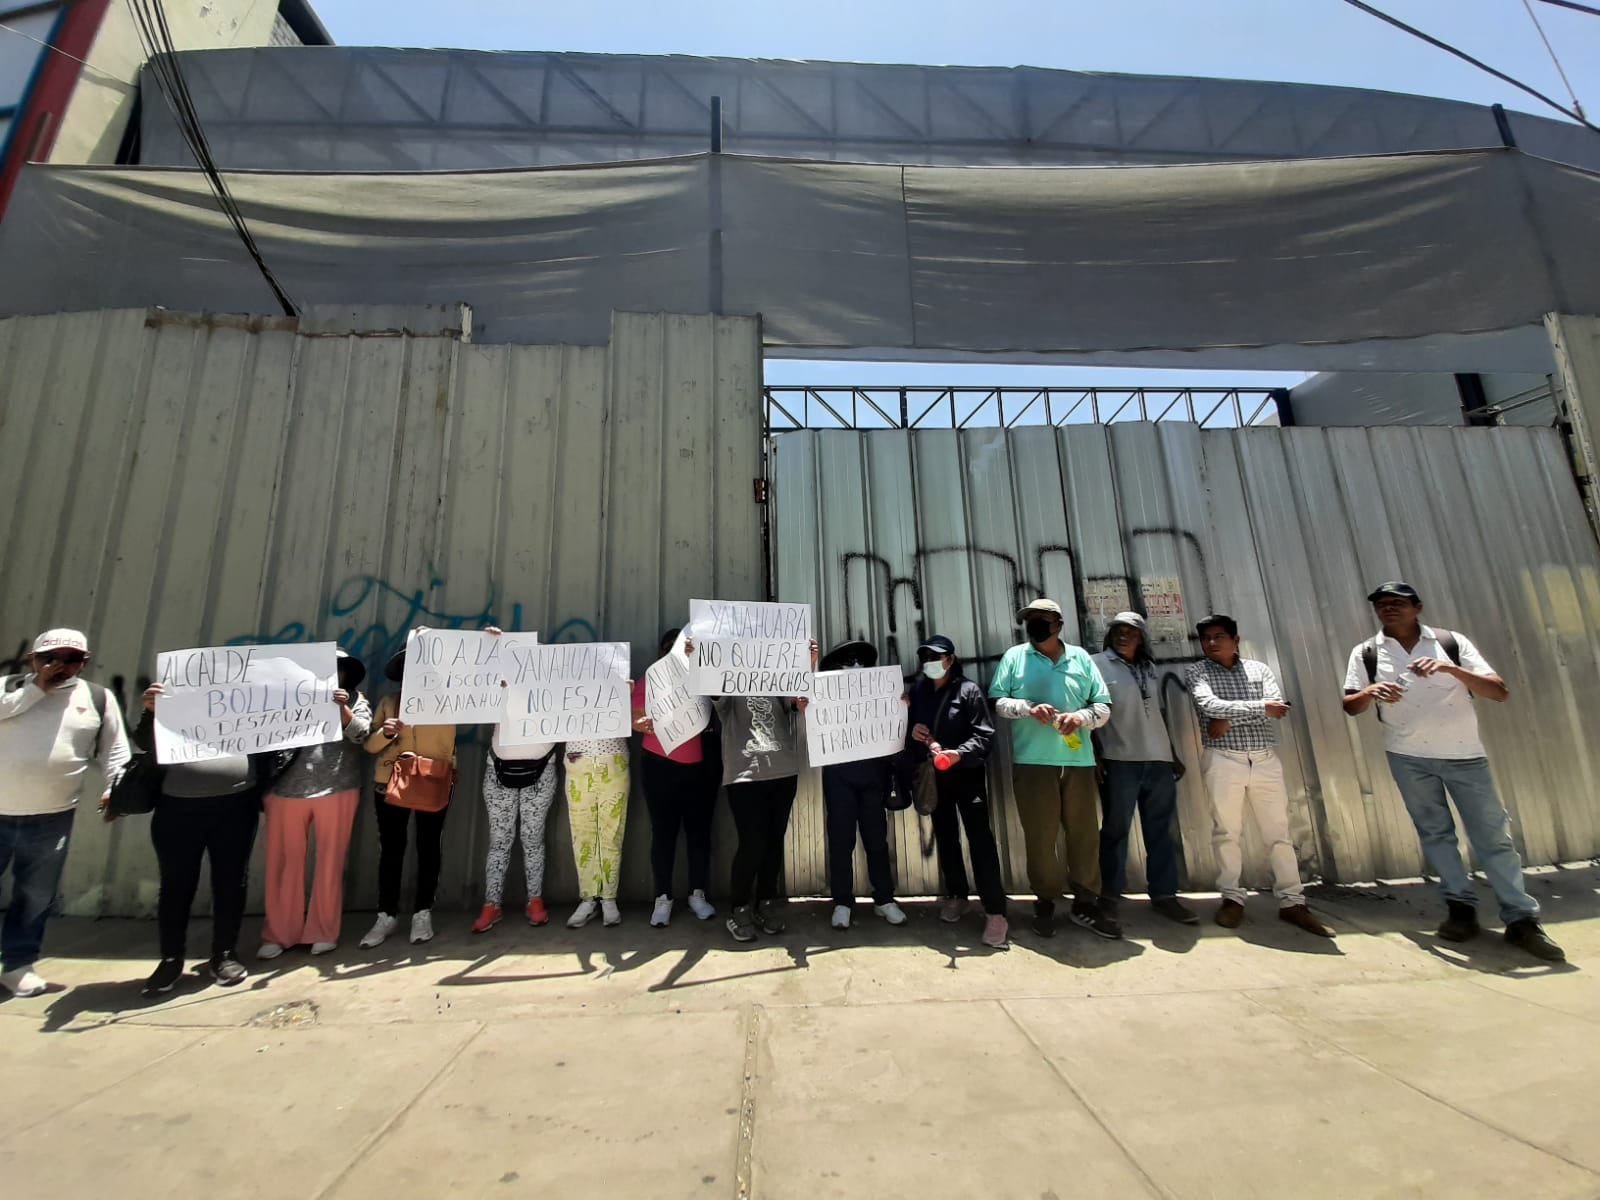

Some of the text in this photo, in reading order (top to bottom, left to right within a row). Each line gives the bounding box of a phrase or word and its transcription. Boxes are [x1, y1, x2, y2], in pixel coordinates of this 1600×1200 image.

[709, 605, 807, 640] YANAHUARA
[415, 635, 444, 666] NO
[451, 638, 467, 667] A
[511, 646, 621, 684] YANAHUARA
[698, 641, 805, 669] NO QUIERE
[161, 648, 257, 688] ALCALDE
[720, 670, 810, 694] BORRACHOS
[527, 684, 623, 714] NO ES LA
[813, 670, 896, 702] QUEREMOS
[404, 696, 425, 715] EN
[181, 708, 314, 742] NO DESTRUYA
[520, 711, 622, 737] DOLORES
[170, 720, 332, 762] NUESTRO DISTRITO
